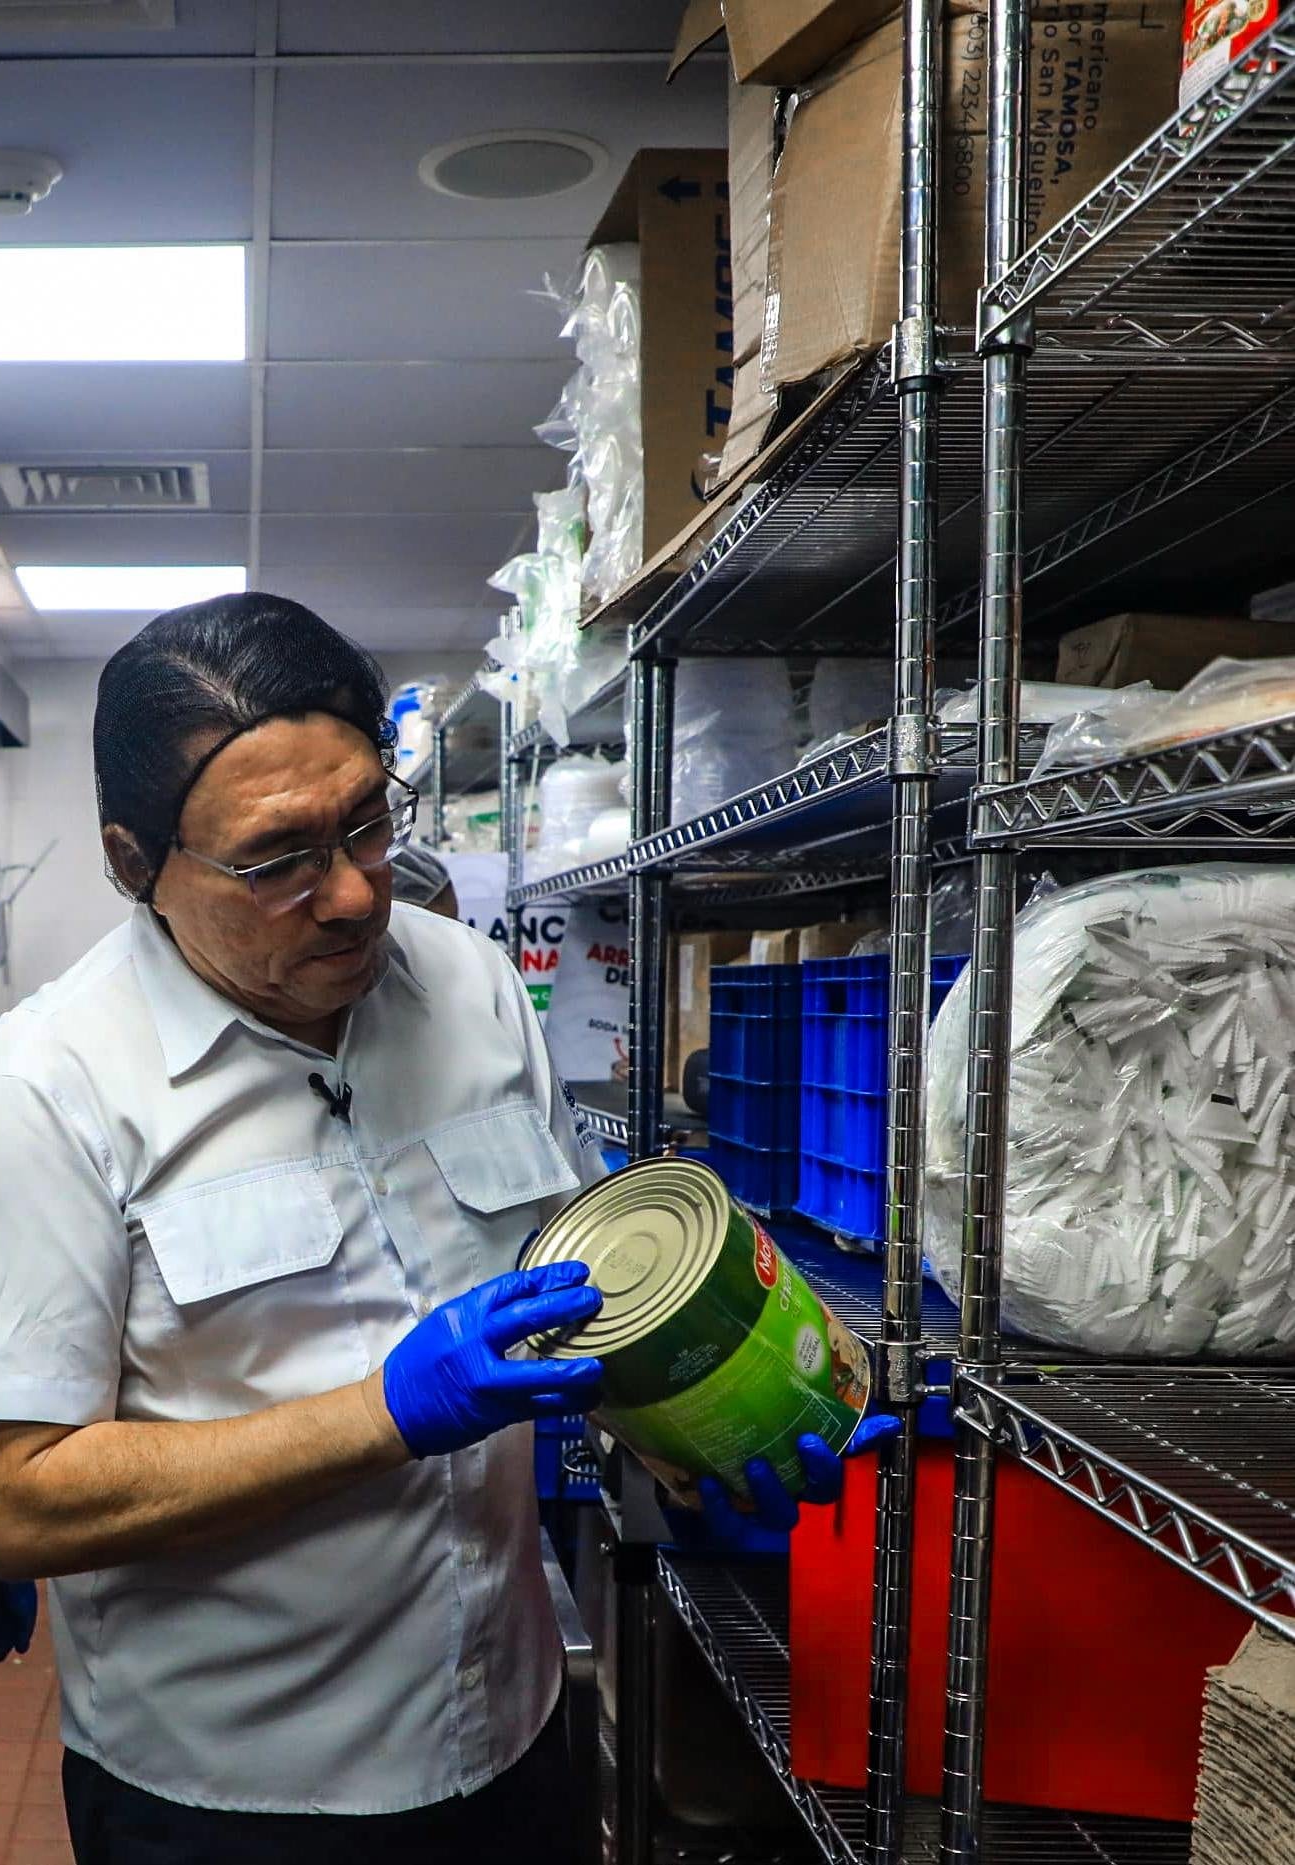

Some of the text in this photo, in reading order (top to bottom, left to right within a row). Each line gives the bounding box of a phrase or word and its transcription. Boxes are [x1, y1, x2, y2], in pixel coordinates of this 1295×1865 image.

[1037, 49, 1060, 97] San
[1050, 4, 1085, 186] por TAMOSA,
[1083, 3, 1110, 130] mericano
